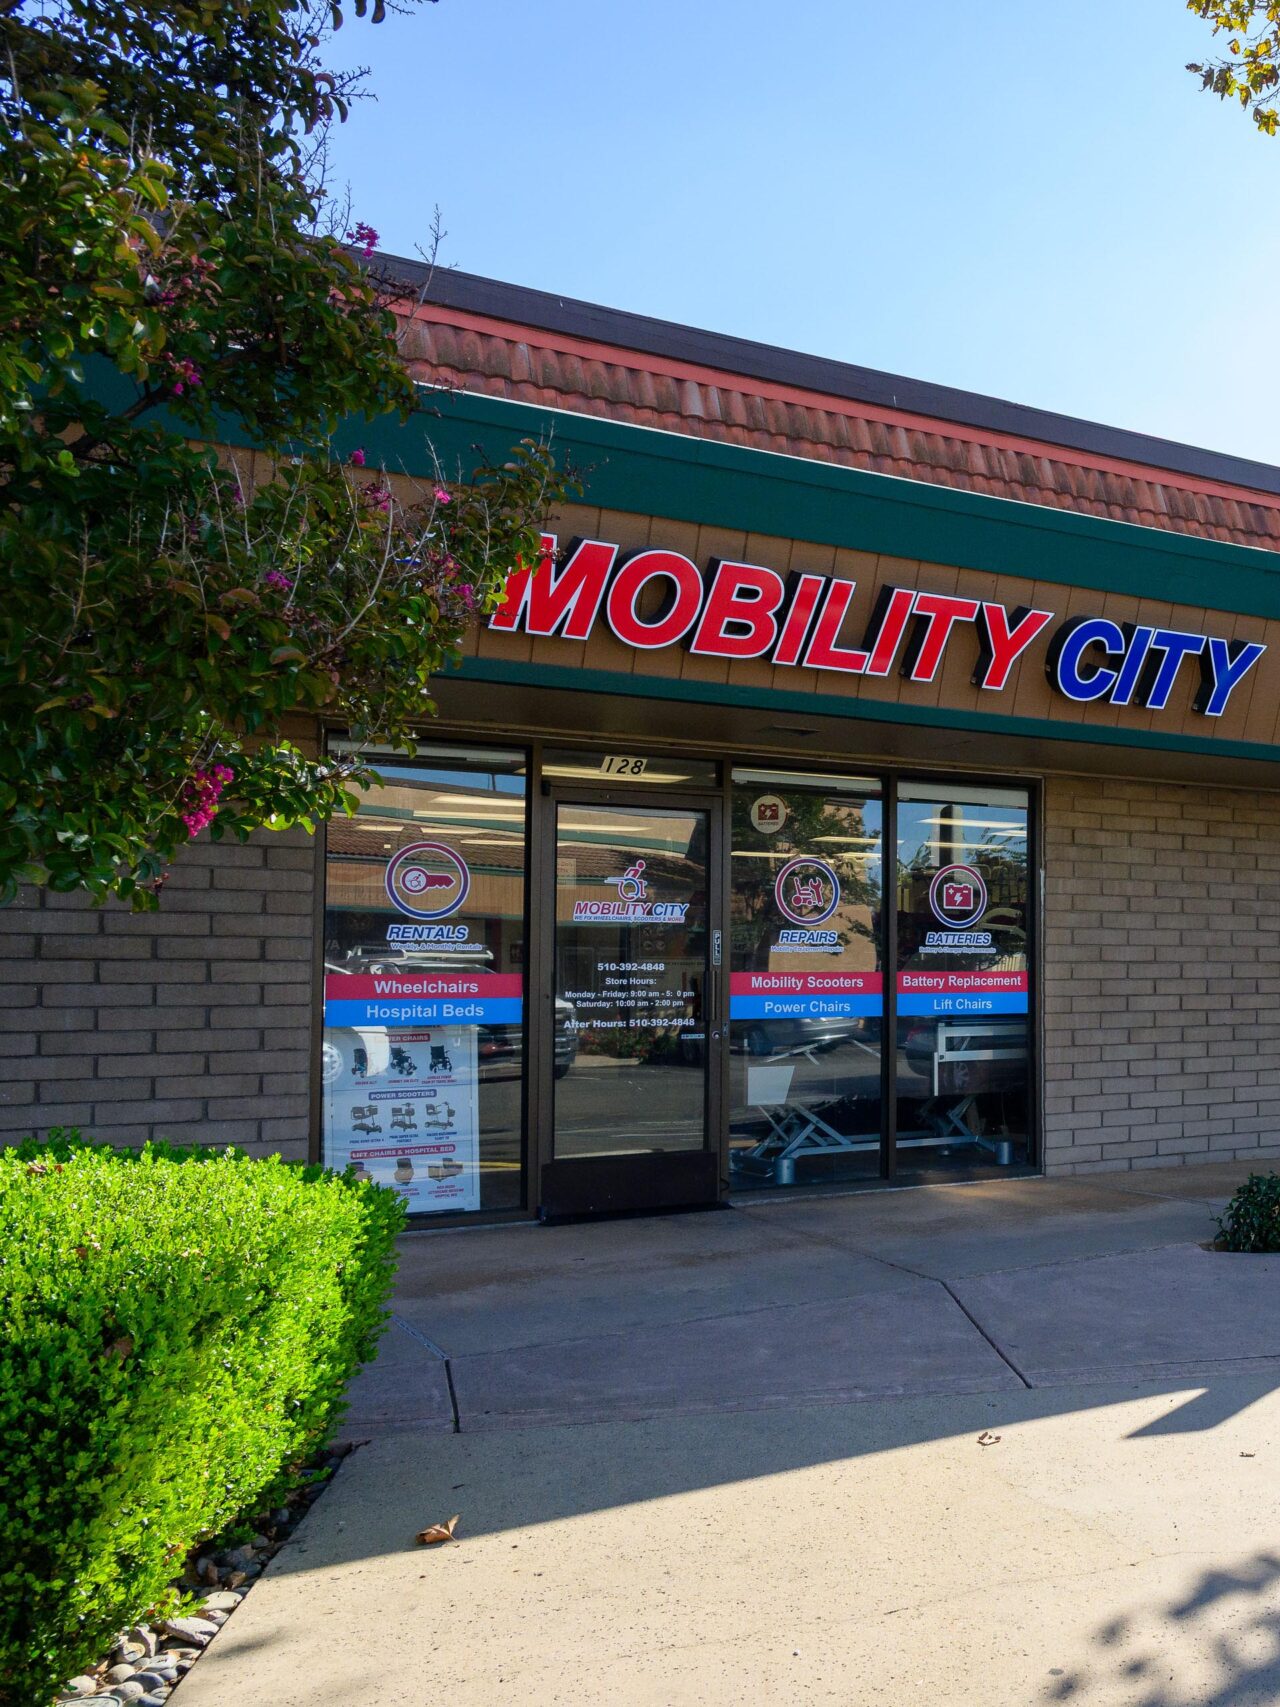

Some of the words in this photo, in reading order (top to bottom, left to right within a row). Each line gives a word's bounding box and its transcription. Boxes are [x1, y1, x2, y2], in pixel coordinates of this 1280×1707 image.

[489, 533, 1055, 690] MOBILITY
[1056, 618, 1267, 716] CITY
[606, 757, 644, 775] 128
[574, 901, 652, 916] MOBILITY
[652, 903, 689, 917] CITY
[387, 924, 469, 940] RENTALS
[779, 930, 838, 944] REPAIRS
[925, 932, 992, 945] BATTERIES
[428, 942, 455, 951] Monthly
[597, 963, 665, 971] 510-392-4848
[374, 980, 479, 994] Wheelchairs
[605, 977, 628, 985] Store
[629, 977, 657, 985] Hours:
[752, 976, 803, 990] Mobility
[807, 976, 864, 987] Scooters
[902, 976, 944, 989] Battery
[948, 975, 1022, 988] Replacement
[565, 991, 596, 999] Monday
[602, 991, 629, 999] Friday:
[683, 991, 695, 999] pm
[576, 1000, 613, 1008] Saturday:
[765, 1001, 806, 1013] Power
[810, 1000, 851, 1012] Chairs
[934, 999, 952, 1010] Lift
[956, 998, 993, 1010] Chairs
[366, 1004, 437, 1020] Hospital
[442, 1003, 485, 1017] Beds
[563, 1019, 590, 1029] After
[592, 1019, 627, 1028] Hours:
[629, 1018, 695, 1027] 510-392-4848
[402, 1034, 429, 1042] CHAIRS
[370, 1091, 396, 1100] POWER
[397, 1090, 435, 1098] SCOOTERS
[369, 1150, 396, 1158] CHAIRS
[404, 1147, 439, 1155] HOSPITAL
